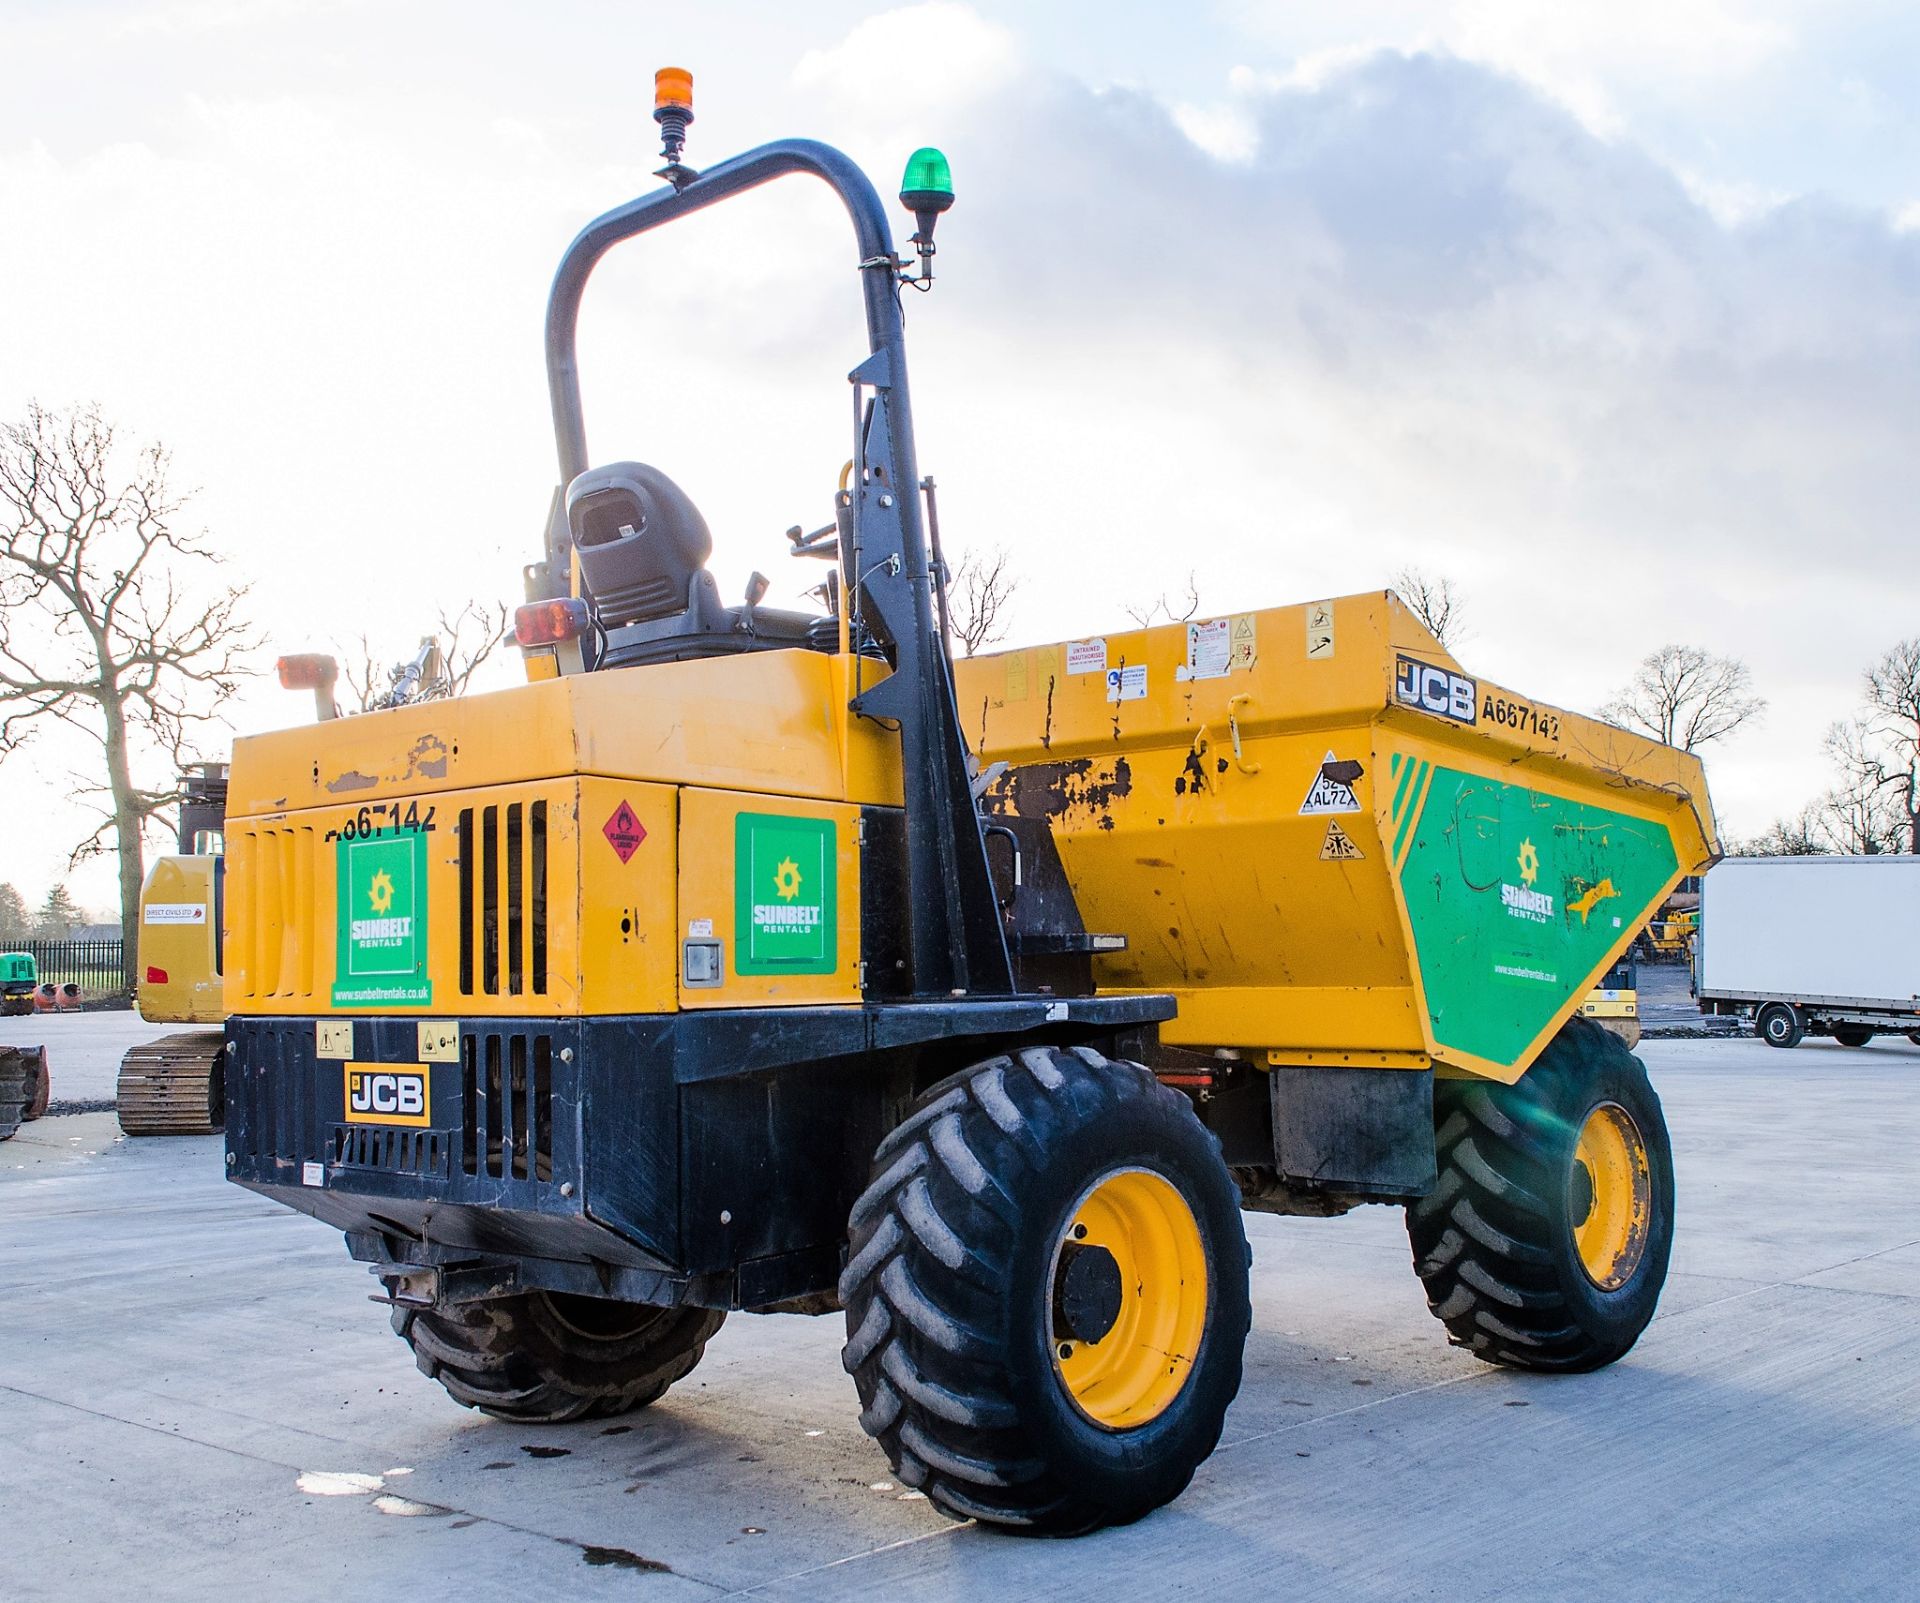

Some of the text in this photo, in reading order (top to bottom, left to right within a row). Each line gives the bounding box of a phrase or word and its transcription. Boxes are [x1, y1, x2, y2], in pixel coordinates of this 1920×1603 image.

[1068, 651, 1105, 662] UNAUTHORISED
[1072, 645, 1101, 655] UNTRAINED
[1398, 663, 1475, 721] JCB
[1482, 695, 1559, 742] A667142
[1500, 882, 1554, 917] SUNBELT
[753, 904, 820, 925] SUNBELT
[1507, 906, 1547, 924] RENTALS
[351, 916, 412, 941] SUNBELT
[763, 925, 812, 934] RENTALS
[359, 938, 403, 949] RENTALS
[335, 986, 428, 1001] www.sunbeltrentals.co.uk
[351, 1074, 424, 1114] JCB
